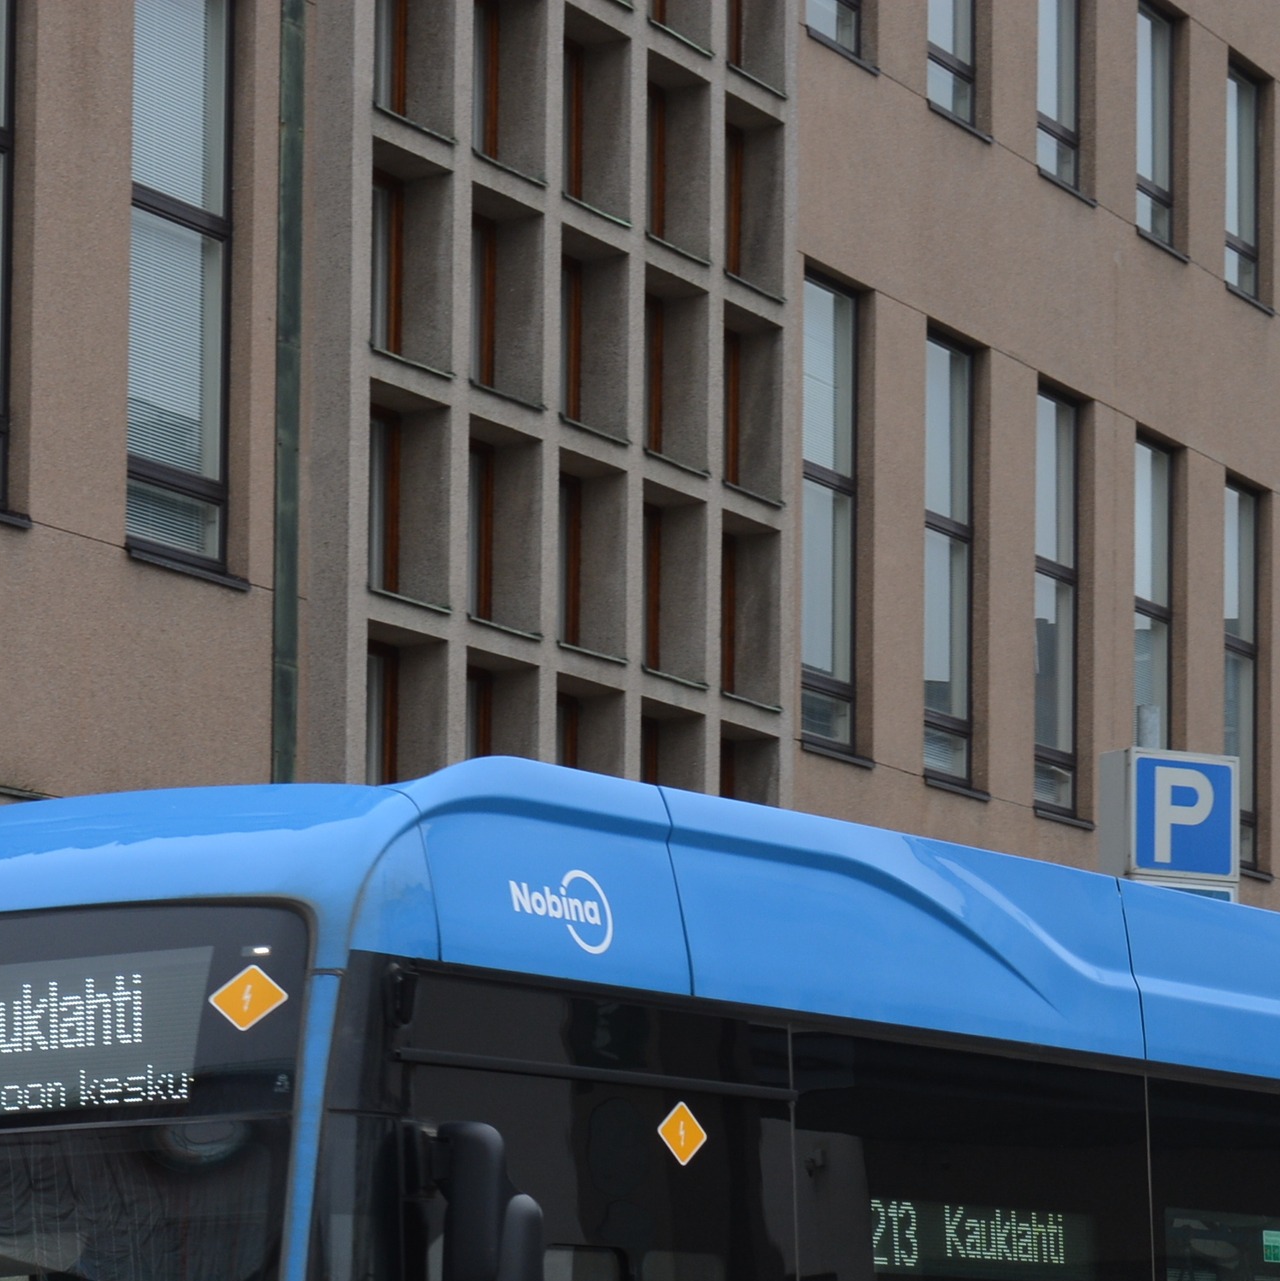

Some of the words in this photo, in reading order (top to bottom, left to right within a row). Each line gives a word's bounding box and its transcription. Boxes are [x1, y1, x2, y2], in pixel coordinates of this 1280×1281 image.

[1154, 766, 1214, 863] P
[509, 880, 601, 926] Nobina
[871, 1200, 918, 1267] 213
[944, 1206, 1065, 1265] Kauklahti
